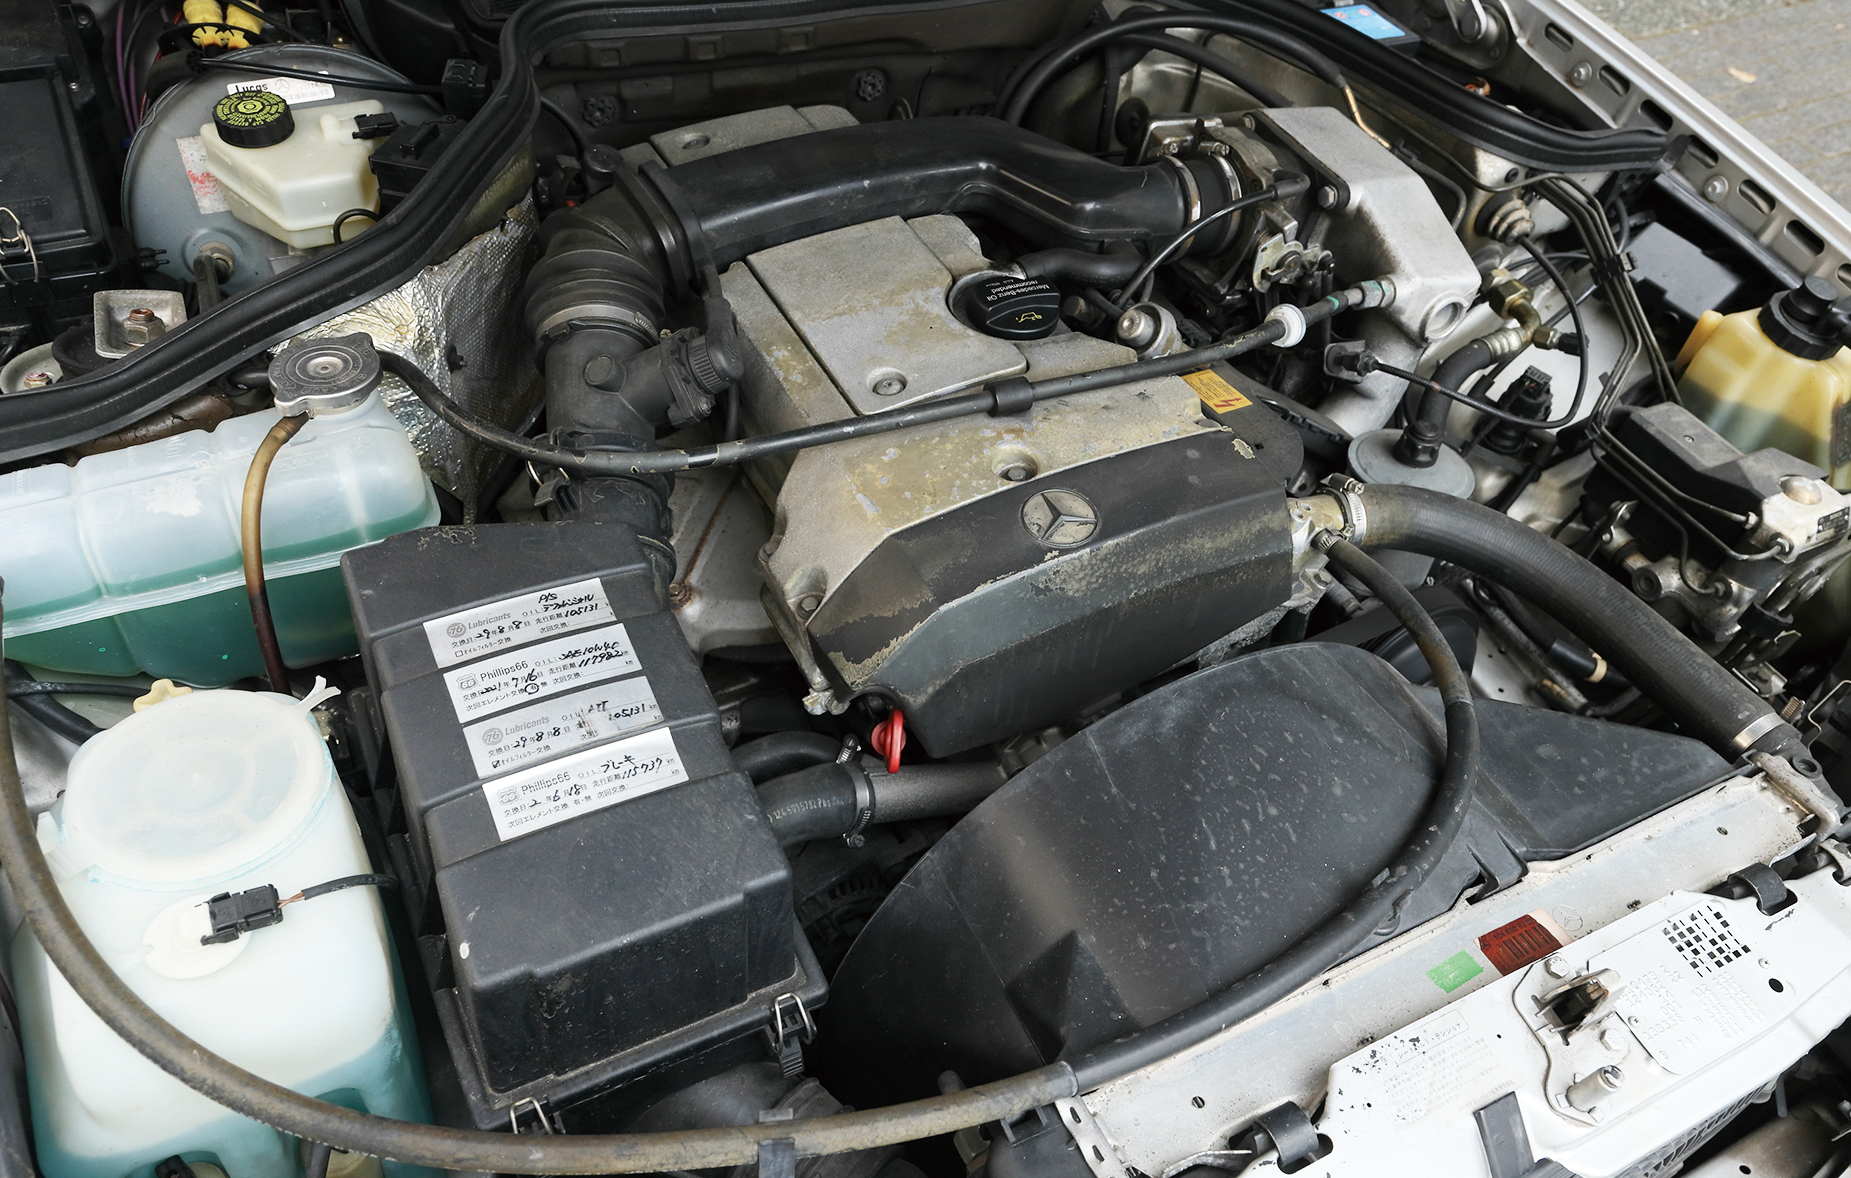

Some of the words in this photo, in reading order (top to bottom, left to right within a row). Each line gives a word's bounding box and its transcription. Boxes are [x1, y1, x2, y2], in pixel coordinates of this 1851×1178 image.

[235, 83, 268, 93] Lucas
[990, 279, 1039, 294] recommended
[998, 284, 1050, 297] Mercedes-Benz
[468, 611, 512, 630] Lubricants
[479, 661, 529, 682] Phillips66
[505, 715, 550, 736] Lubricants
[521, 771, 571, 796] Phillips66
